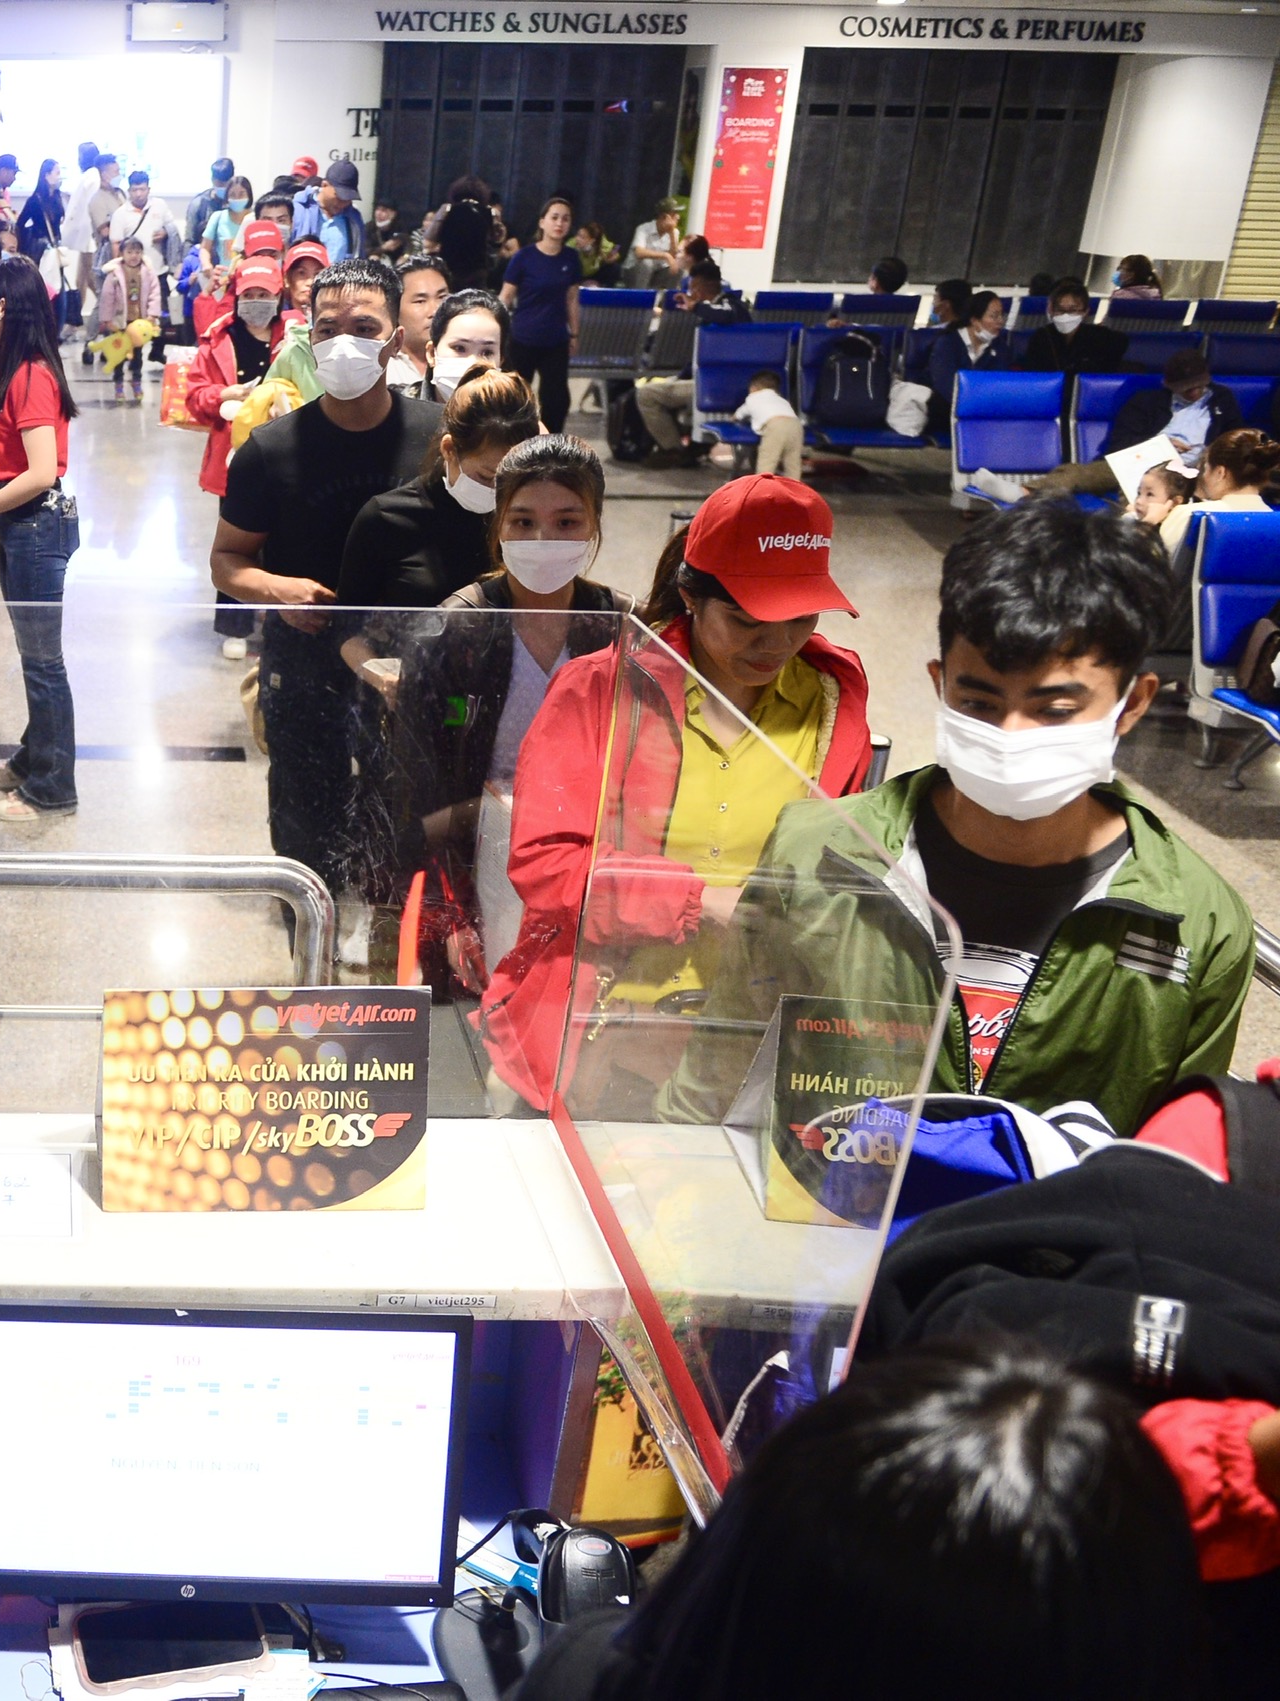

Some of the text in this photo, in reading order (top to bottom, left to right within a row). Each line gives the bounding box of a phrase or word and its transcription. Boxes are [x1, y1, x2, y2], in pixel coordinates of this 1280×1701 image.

[375, 10, 688, 36] WATCHES & SUNGLASSES
[839, 16, 1147, 43] COSMETICS & PERFUMES
[724, 117, 775, 128] BOARDING
[214, 1062, 243, 1083] RA
[249, 1056, 290, 1083] CỬA
[296, 1056, 348, 1082] KHỞI
[354, 1056, 415, 1082] HÀNH
[171, 1089, 369, 1112] PRIORITY BOARDING
[388, 1295, 485, 1308] G7 vietjet295
[181, 1584, 196, 1599] hp
